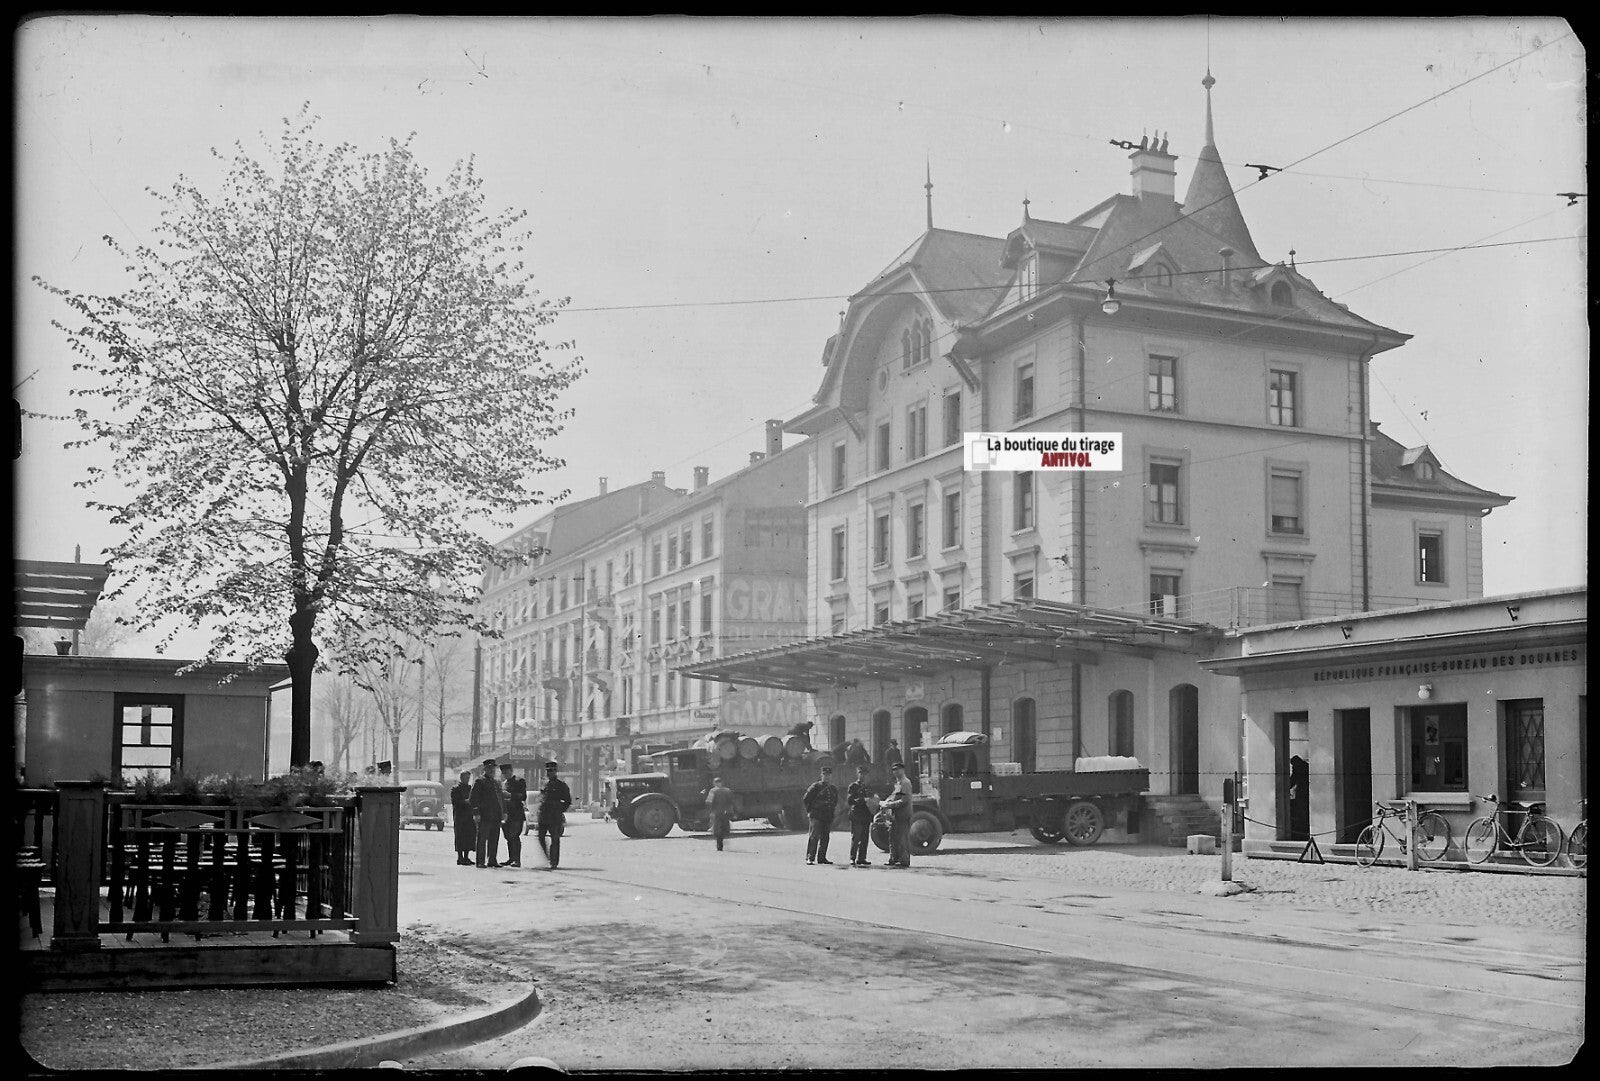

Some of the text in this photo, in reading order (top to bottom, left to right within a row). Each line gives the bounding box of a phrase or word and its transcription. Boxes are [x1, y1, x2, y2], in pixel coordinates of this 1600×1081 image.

[1314, 667, 1374, 682] RÉPUBLIQUE
[1492, 655, 1515, 667] DES
[1520, 649, 1578, 665] DOUANES
